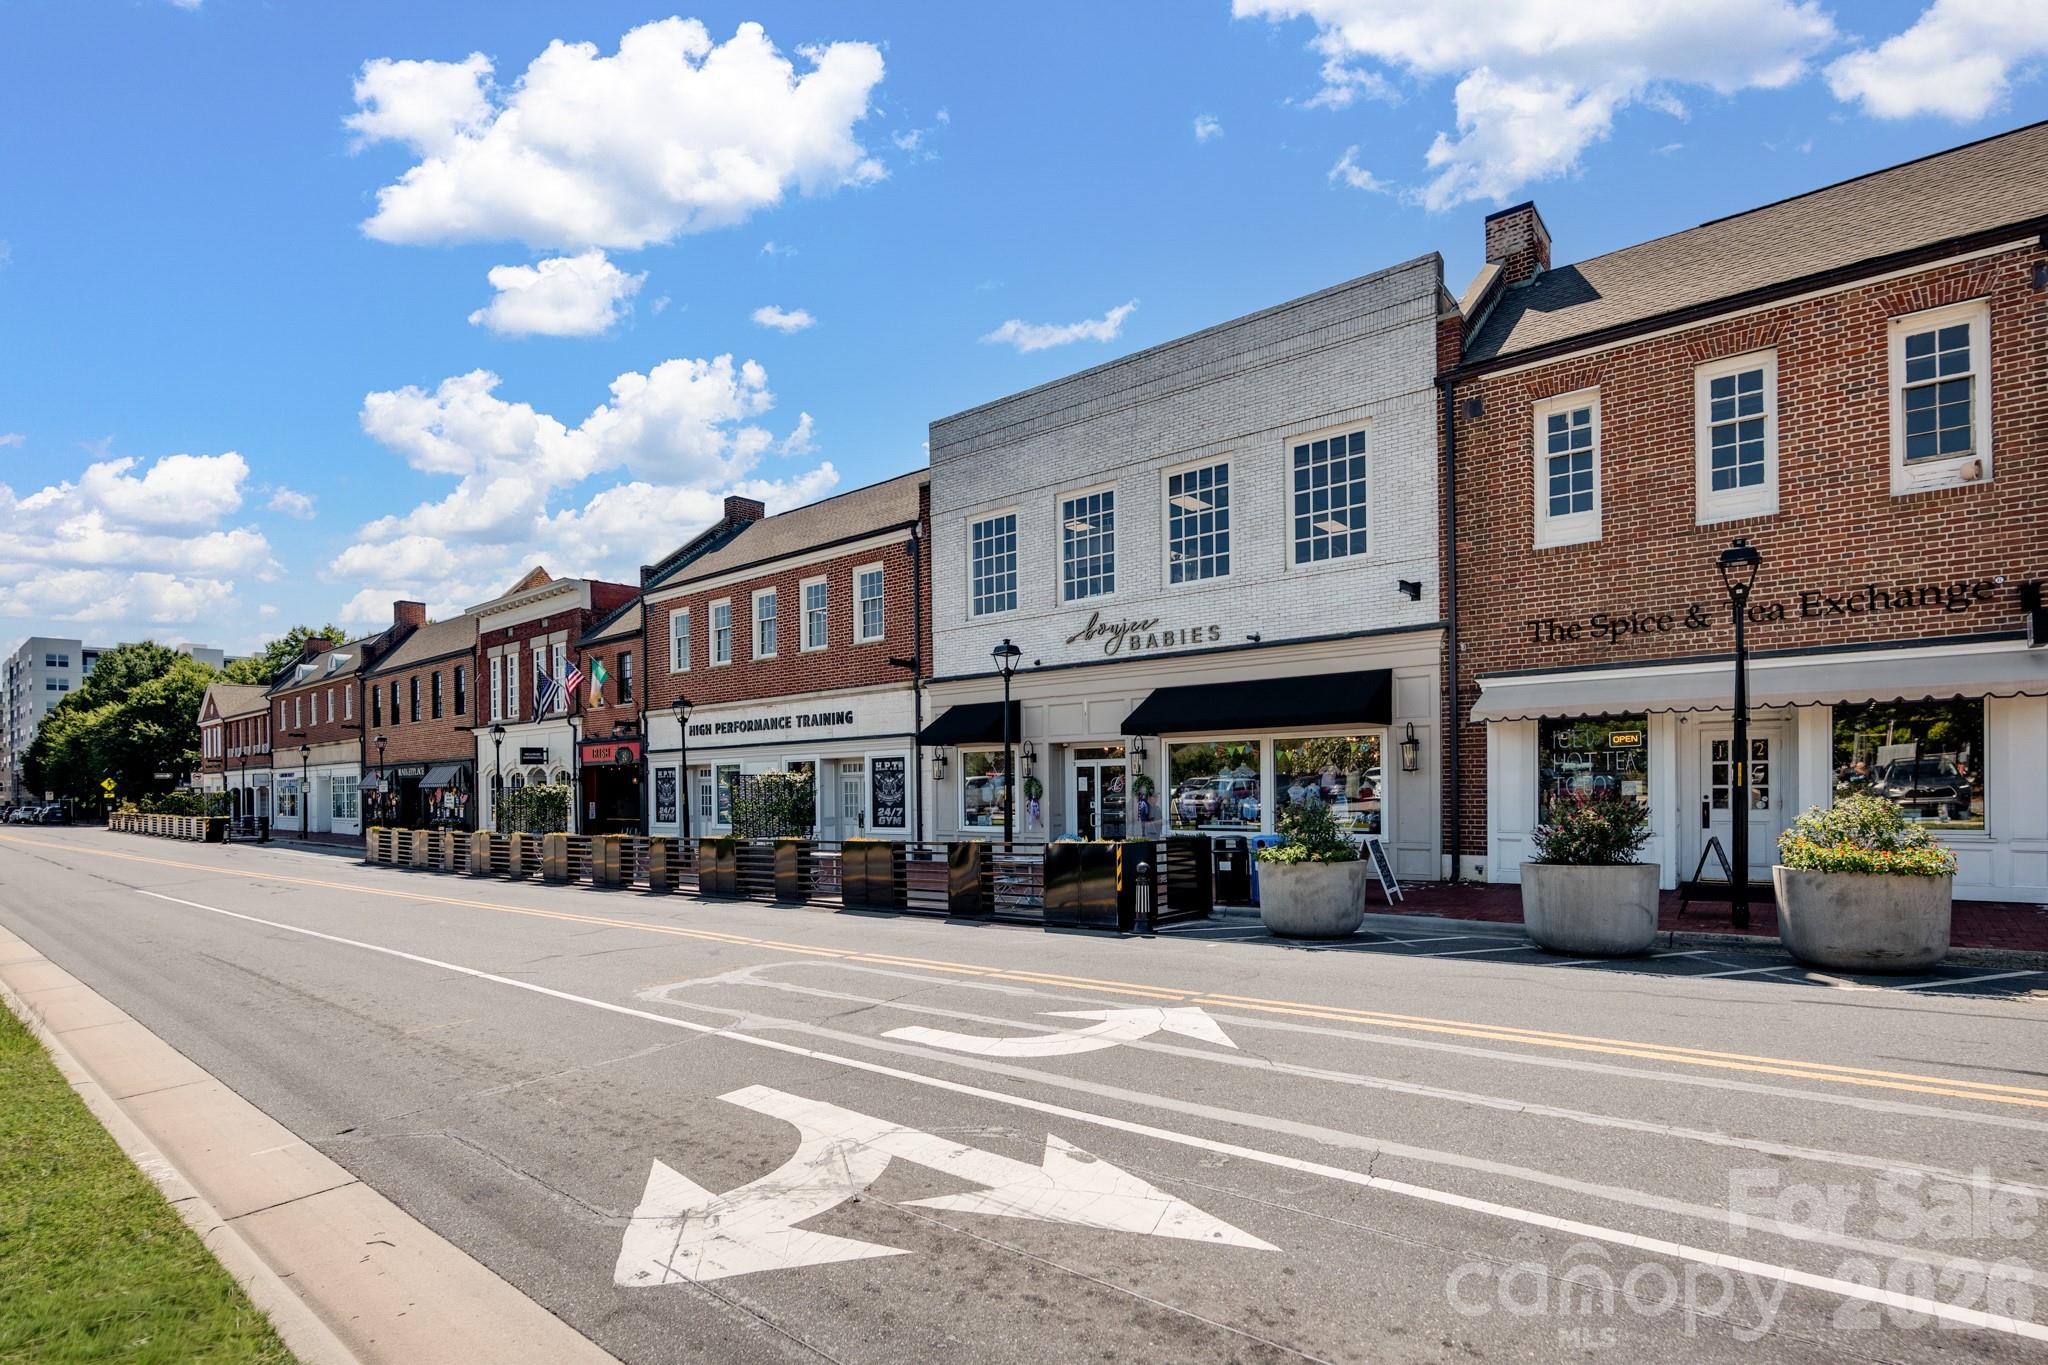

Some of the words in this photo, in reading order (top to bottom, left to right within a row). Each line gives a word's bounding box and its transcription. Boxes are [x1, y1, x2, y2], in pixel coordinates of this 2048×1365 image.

[1528, 618, 1582, 643] The
[1590, 611, 1673, 645] Spice
[1684, 605, 1711, 630] &
[1800, 581, 1996, 618] Exchange
[1066, 612, 1159, 655] boujee
[1130, 624, 1221, 650] BABIES
[689, 724, 712, 737] HIGH
[715, 716, 792, 734] PERFORMANCE
[796, 711, 853, 728] TRAINING
[1613, 735, 1638, 743] OPEN
[1553, 751, 1598, 772] HOT
[1602, 751, 1637, 771] TEA
[878, 807, 903, 817] 24/7
[878, 816, 902, 825] GYM
